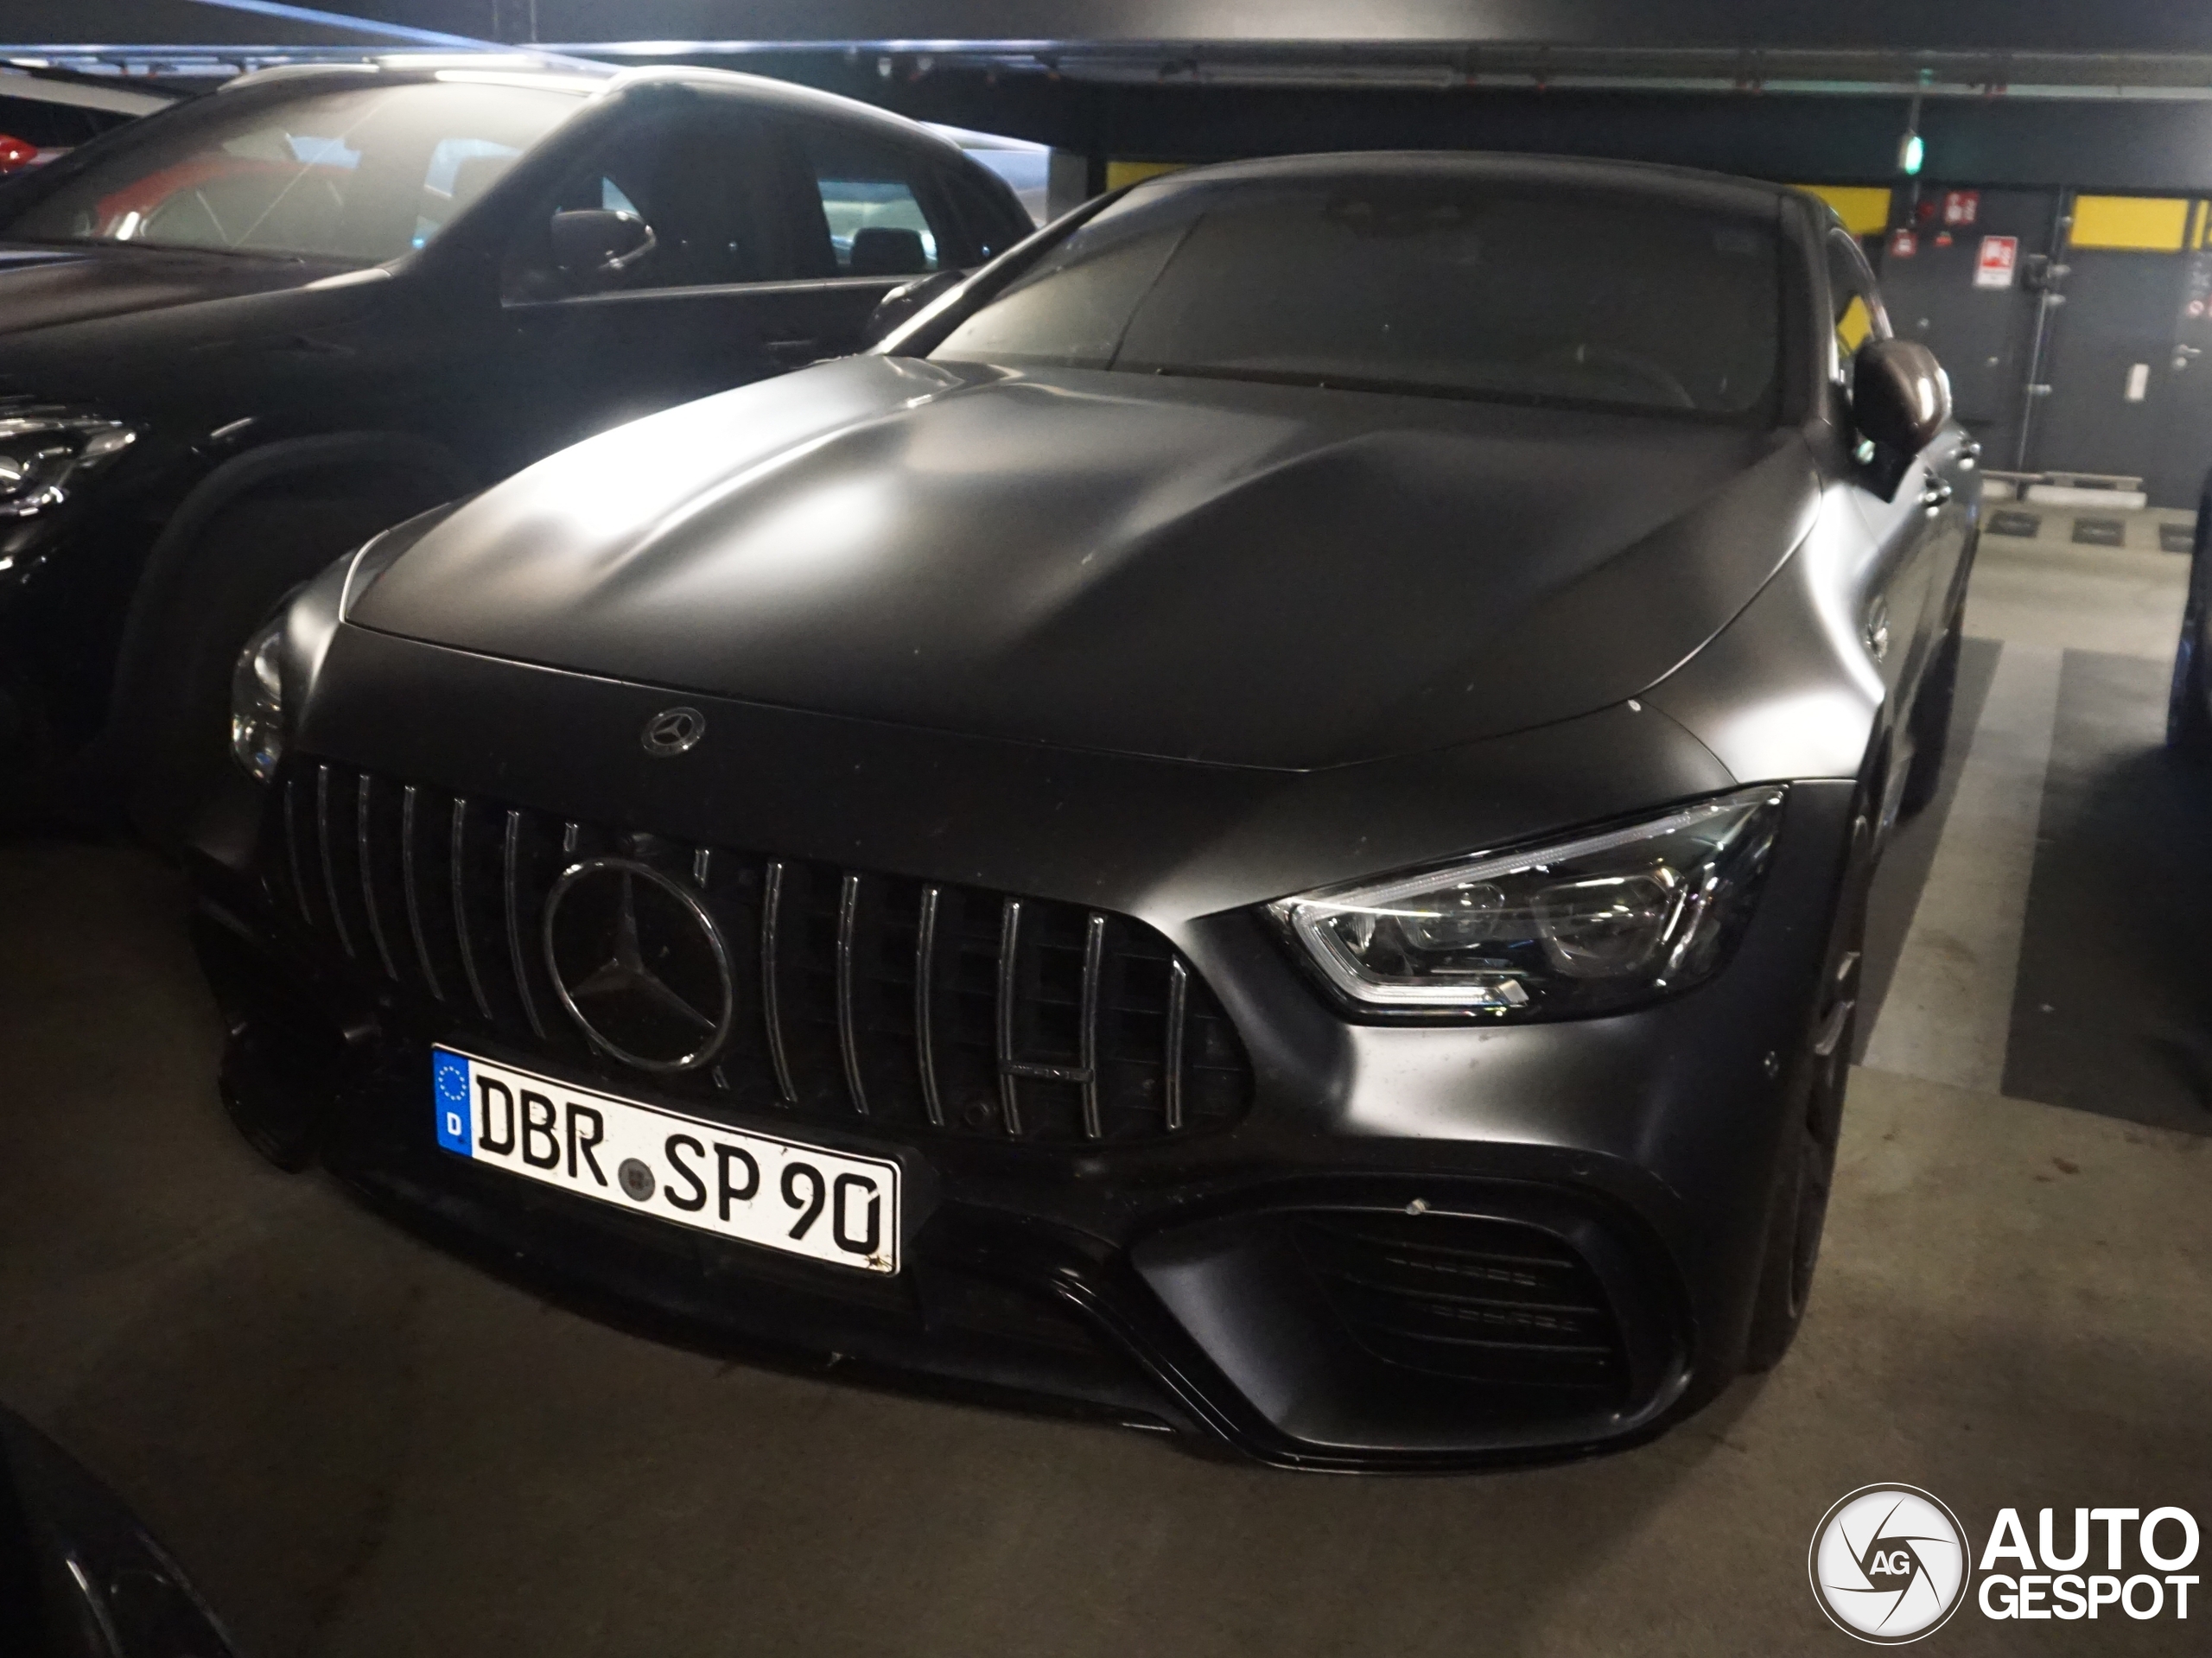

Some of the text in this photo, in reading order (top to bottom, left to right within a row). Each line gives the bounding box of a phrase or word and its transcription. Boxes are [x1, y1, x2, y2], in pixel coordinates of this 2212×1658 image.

[447, 1112, 461, 1136] D
[476, 1074, 880, 1255] DBR SP 90
